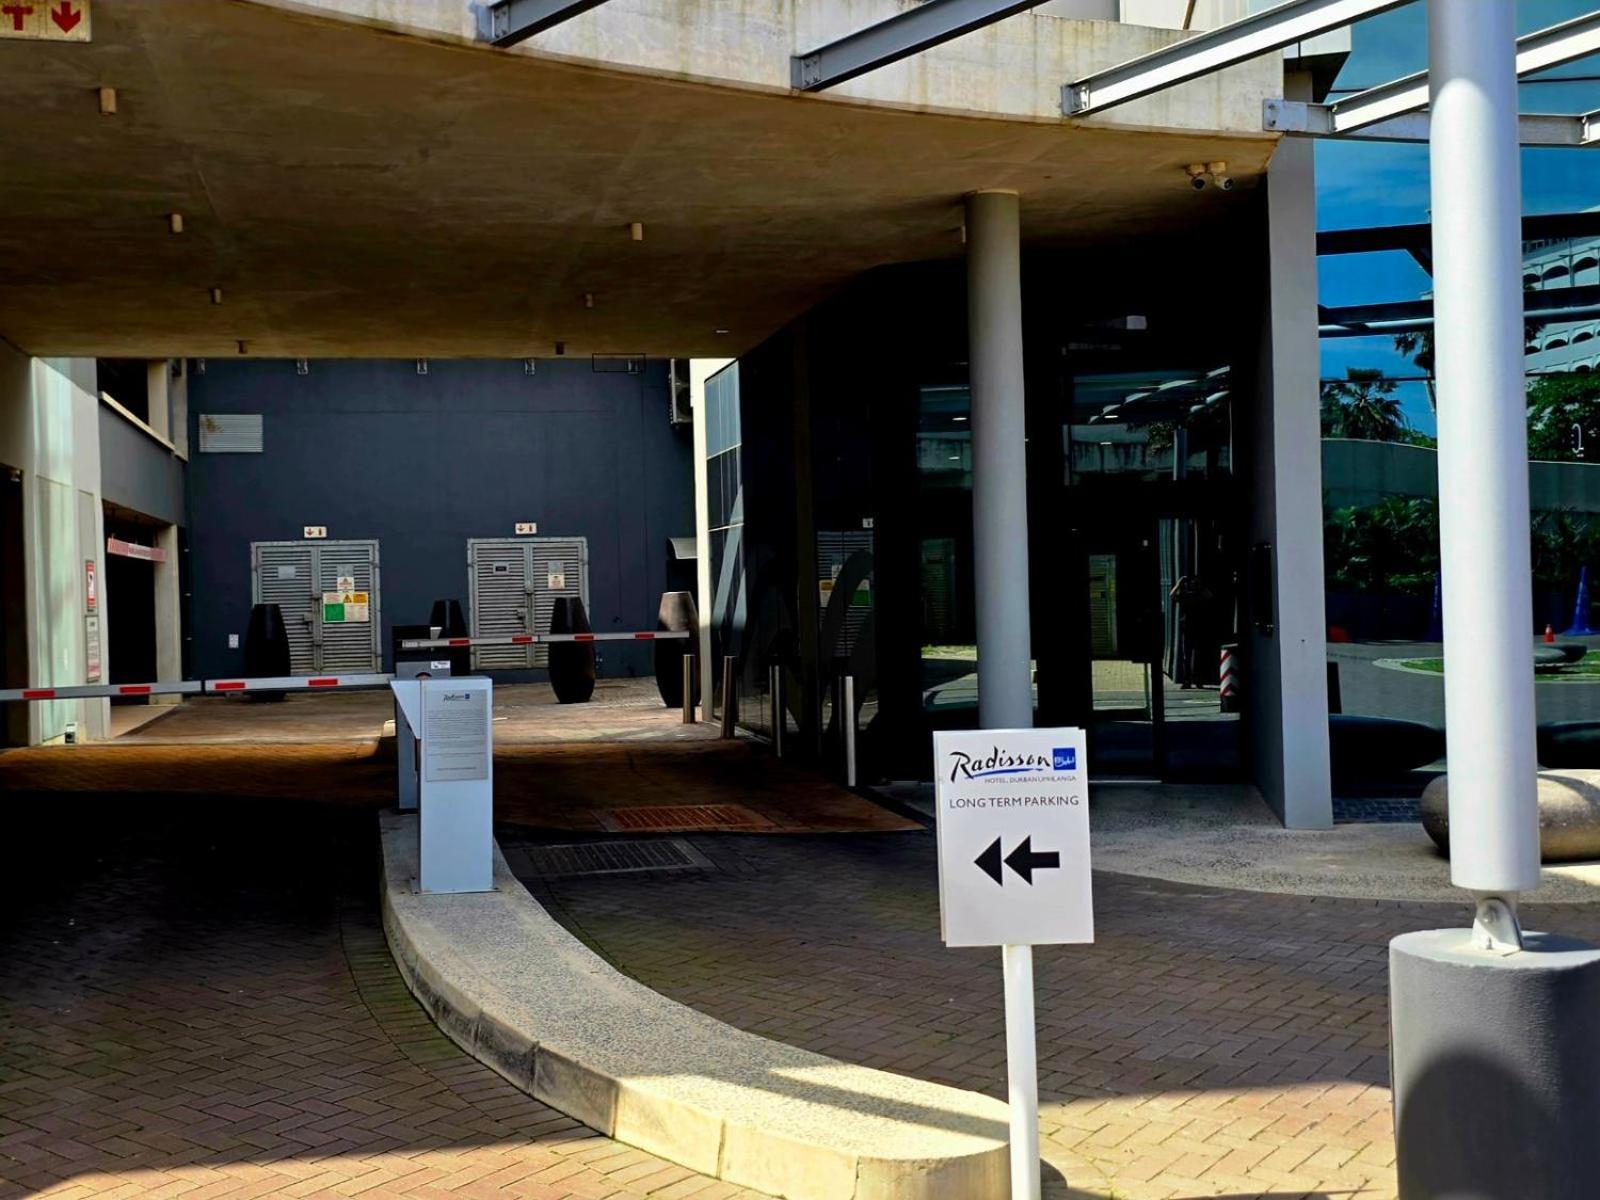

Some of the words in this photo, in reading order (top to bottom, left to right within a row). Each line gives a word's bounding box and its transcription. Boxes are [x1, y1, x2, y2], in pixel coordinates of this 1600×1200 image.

[949, 745, 1051, 783] Radisson
[949, 798, 986, 809] LONG
[987, 797, 1022, 808] TERM
[1024, 795, 1080, 807] PARKING
